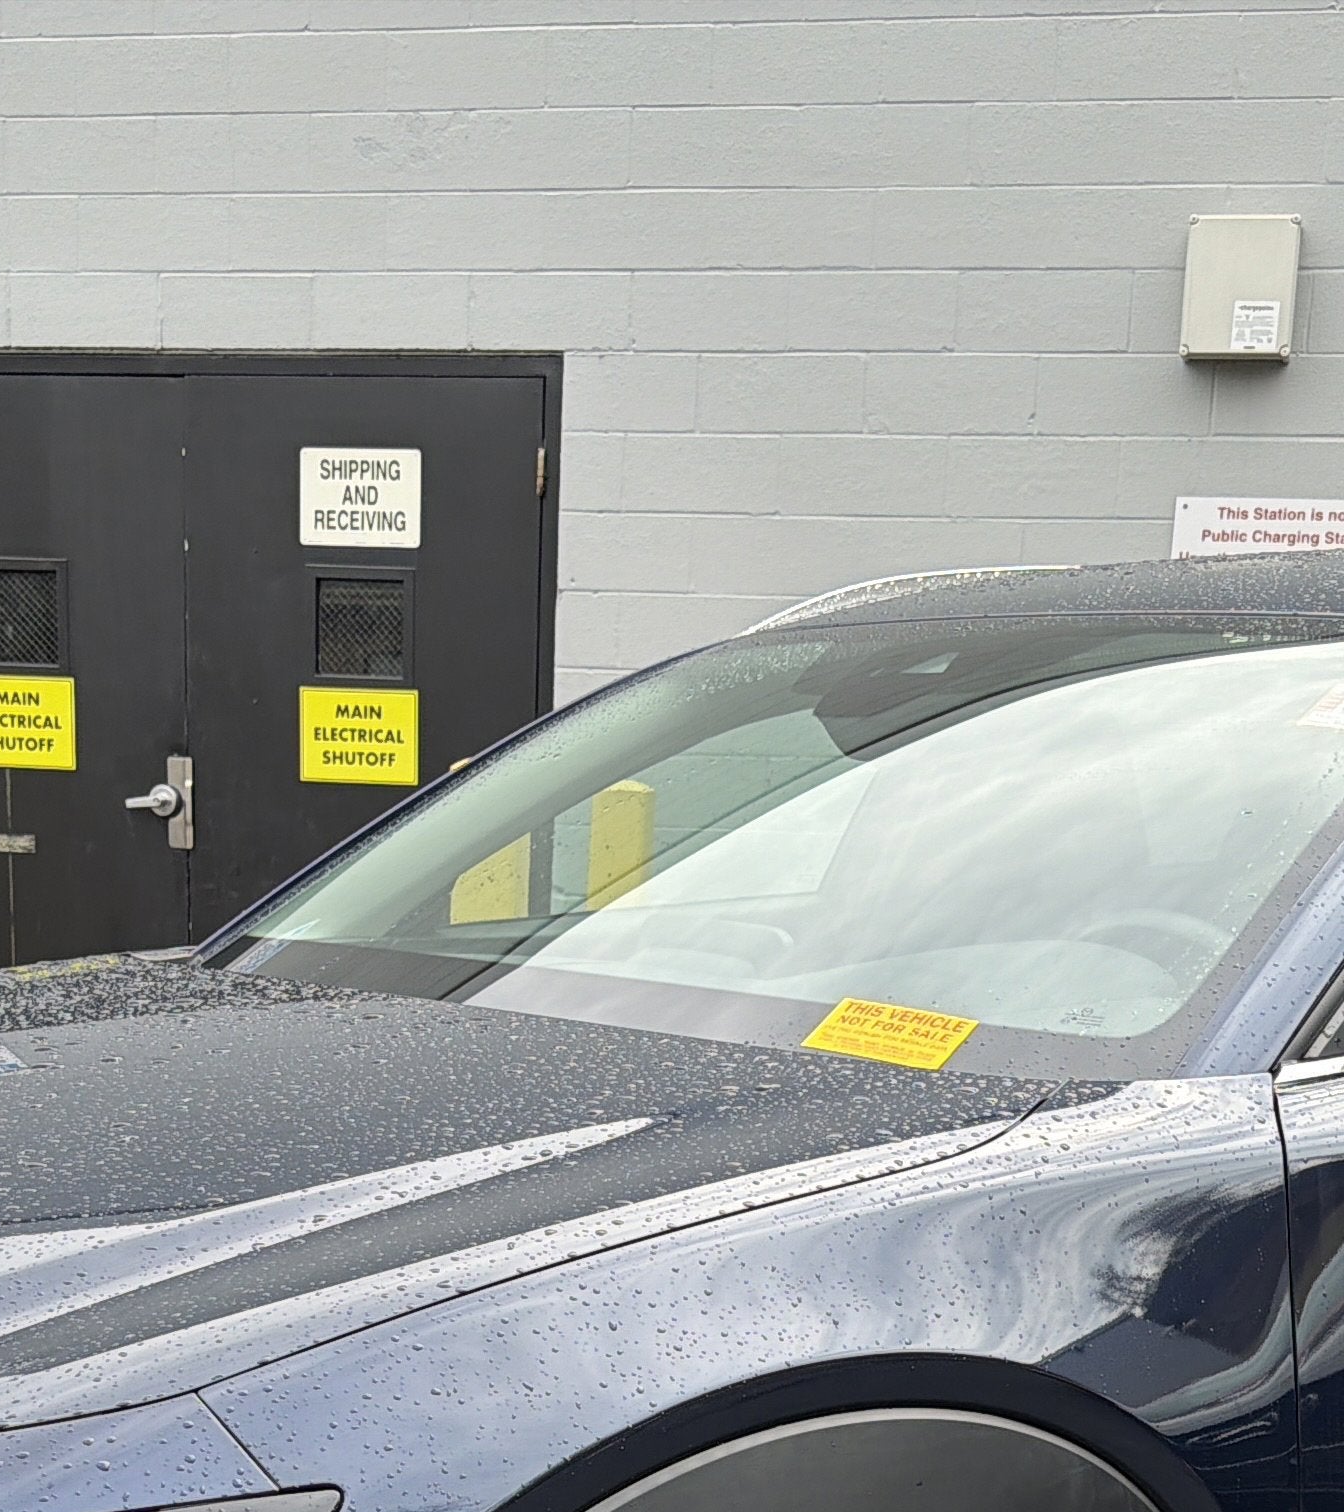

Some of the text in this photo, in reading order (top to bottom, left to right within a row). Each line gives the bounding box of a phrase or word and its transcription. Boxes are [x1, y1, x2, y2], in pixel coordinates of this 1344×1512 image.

[319, 459, 401, 481] SHIPPING
[342, 485, 379, 505] AND
[314, 509, 406, 531] RECEIVING
[1218, 506, 1249, 521] This
[1253, 507, 1306, 521] Station
[1311, 508, 1323, 521] is
[1201, 529, 1248, 543] Public
[1252, 531, 1320, 547] Charging
[336, 704, 382, 720] MAIN
[314, 727, 404, 744] ELECTRICAL
[322, 750, 396, 767] SHUTOFF
[844, 1001, 970, 1034] THIS VEHICLE
[837, 1014, 872, 1029] NOT
[873, 1020, 906, 1035] FOR
[910, 1027, 955, 1044] SALE
